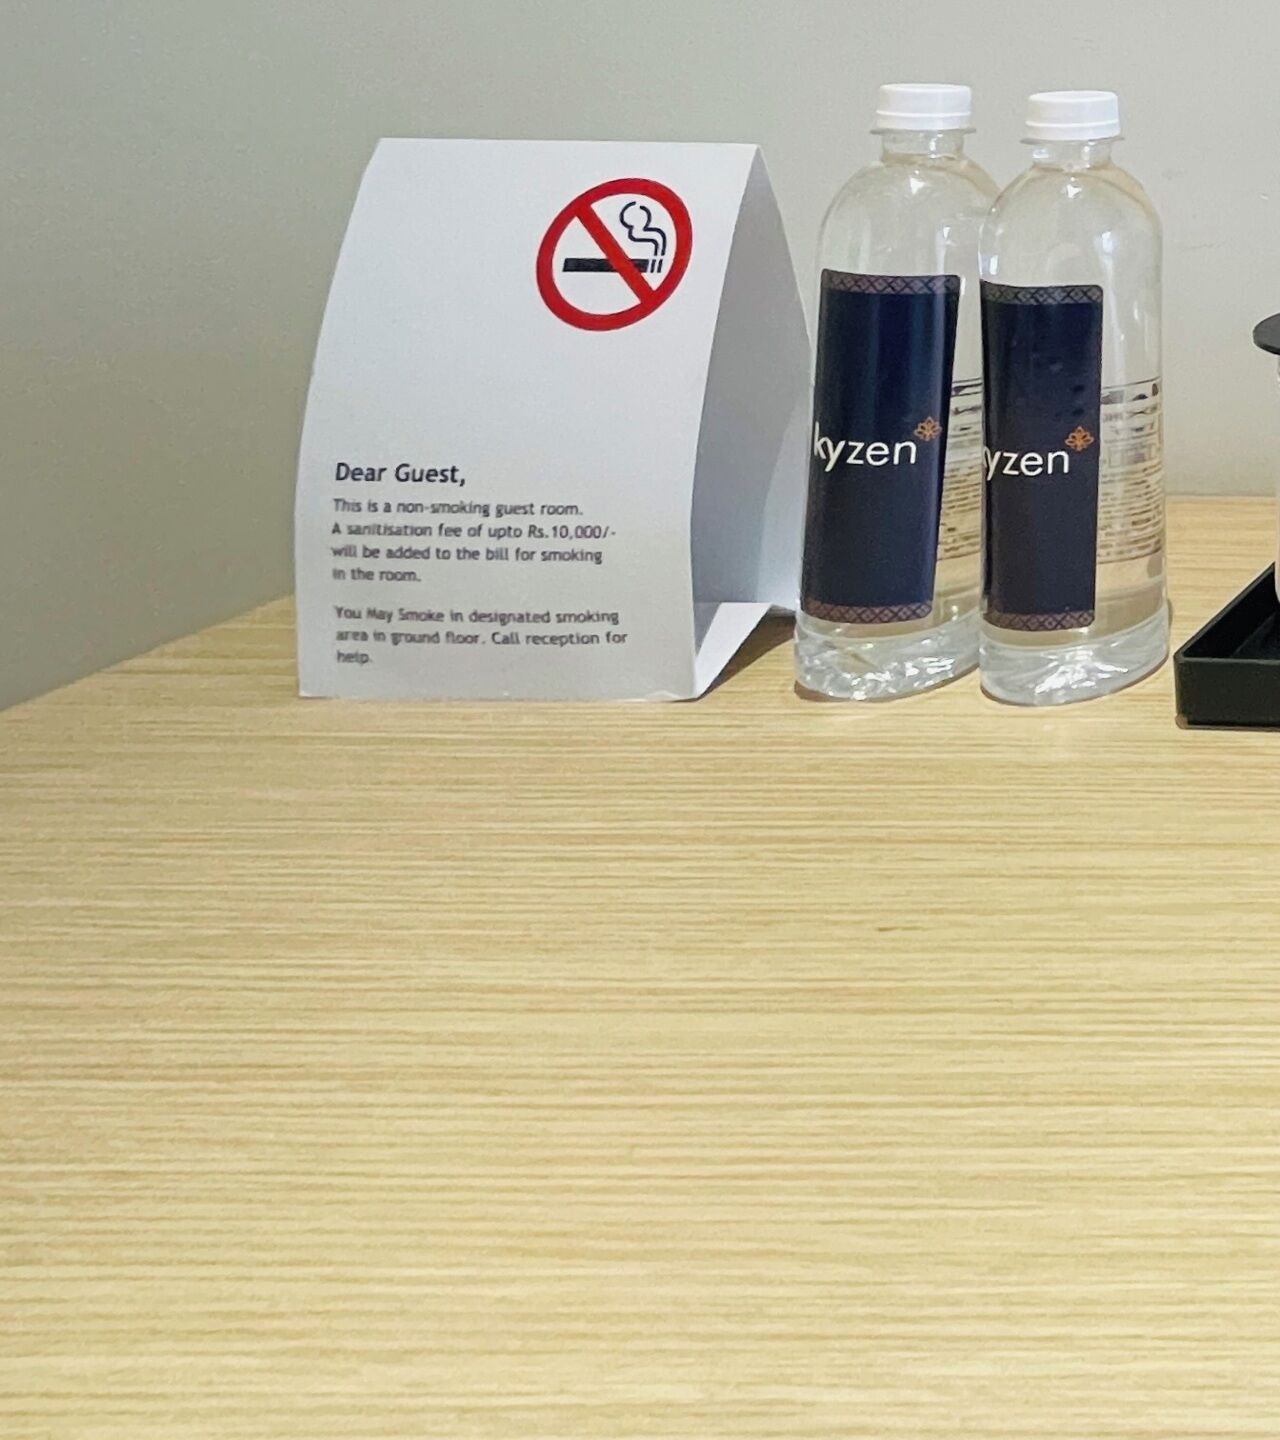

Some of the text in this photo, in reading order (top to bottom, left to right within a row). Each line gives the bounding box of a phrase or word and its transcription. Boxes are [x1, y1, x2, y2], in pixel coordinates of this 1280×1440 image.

[813, 421, 917, 472] kyzen
[335, 462, 466, 487] Dear Guest,
[333, 498, 584, 518] This is a non-smoking guest room.
[331, 522, 342, 535] A
[347, 523, 432, 536] sanitisation
[438, 523, 462, 537] fee
[467, 523, 483, 537] of
[488, 525, 523, 540] upto
[331, 544, 603, 565] will be added to the bill for smoking
[332, 567, 421, 582] in the room.
[334, 606, 619, 626] You May Smoke in designated smoking
[336, 629, 628, 647] area in ground floor. Call reception for
[336, 649, 372, 666] help.
